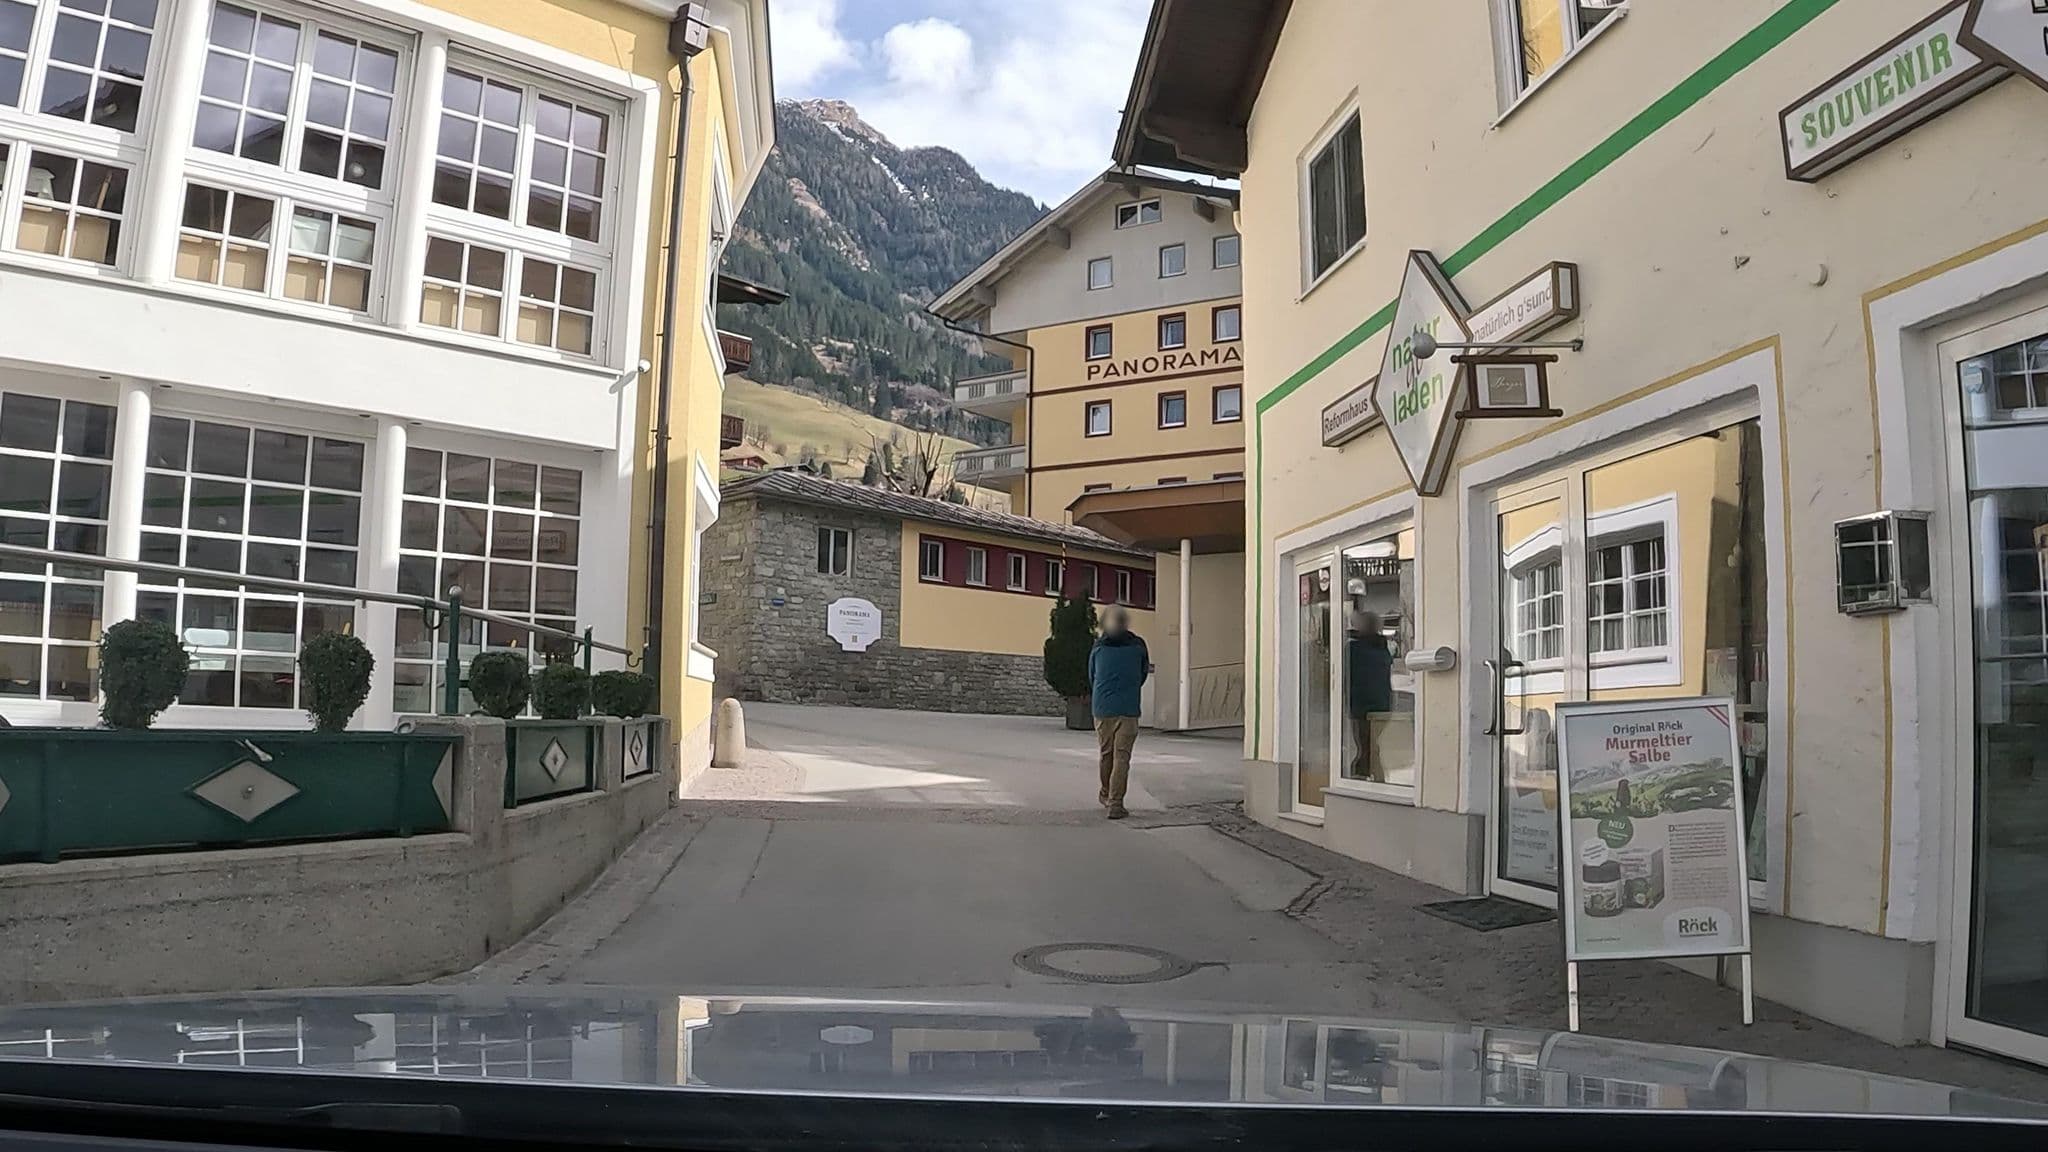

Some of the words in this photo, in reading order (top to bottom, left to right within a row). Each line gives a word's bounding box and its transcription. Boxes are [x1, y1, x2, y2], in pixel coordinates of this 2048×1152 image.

[1801, 32, 1953, 149] SOUVENIR
[1474, 305, 1515, 342] natürlich
[1087, 346, 1241, 381] PANORAMA
[1324, 398, 1368, 434] Reformhaus
[1393, 373, 1443, 426] laden
[1606, 733, 1693, 751] Murmeltier
[1612, 722, 1655, 736] Original
[1658, 720, 1684, 732] Röck
[1629, 748, 1672, 764] Salbe
[1679, 916, 1718, 933] Röck
